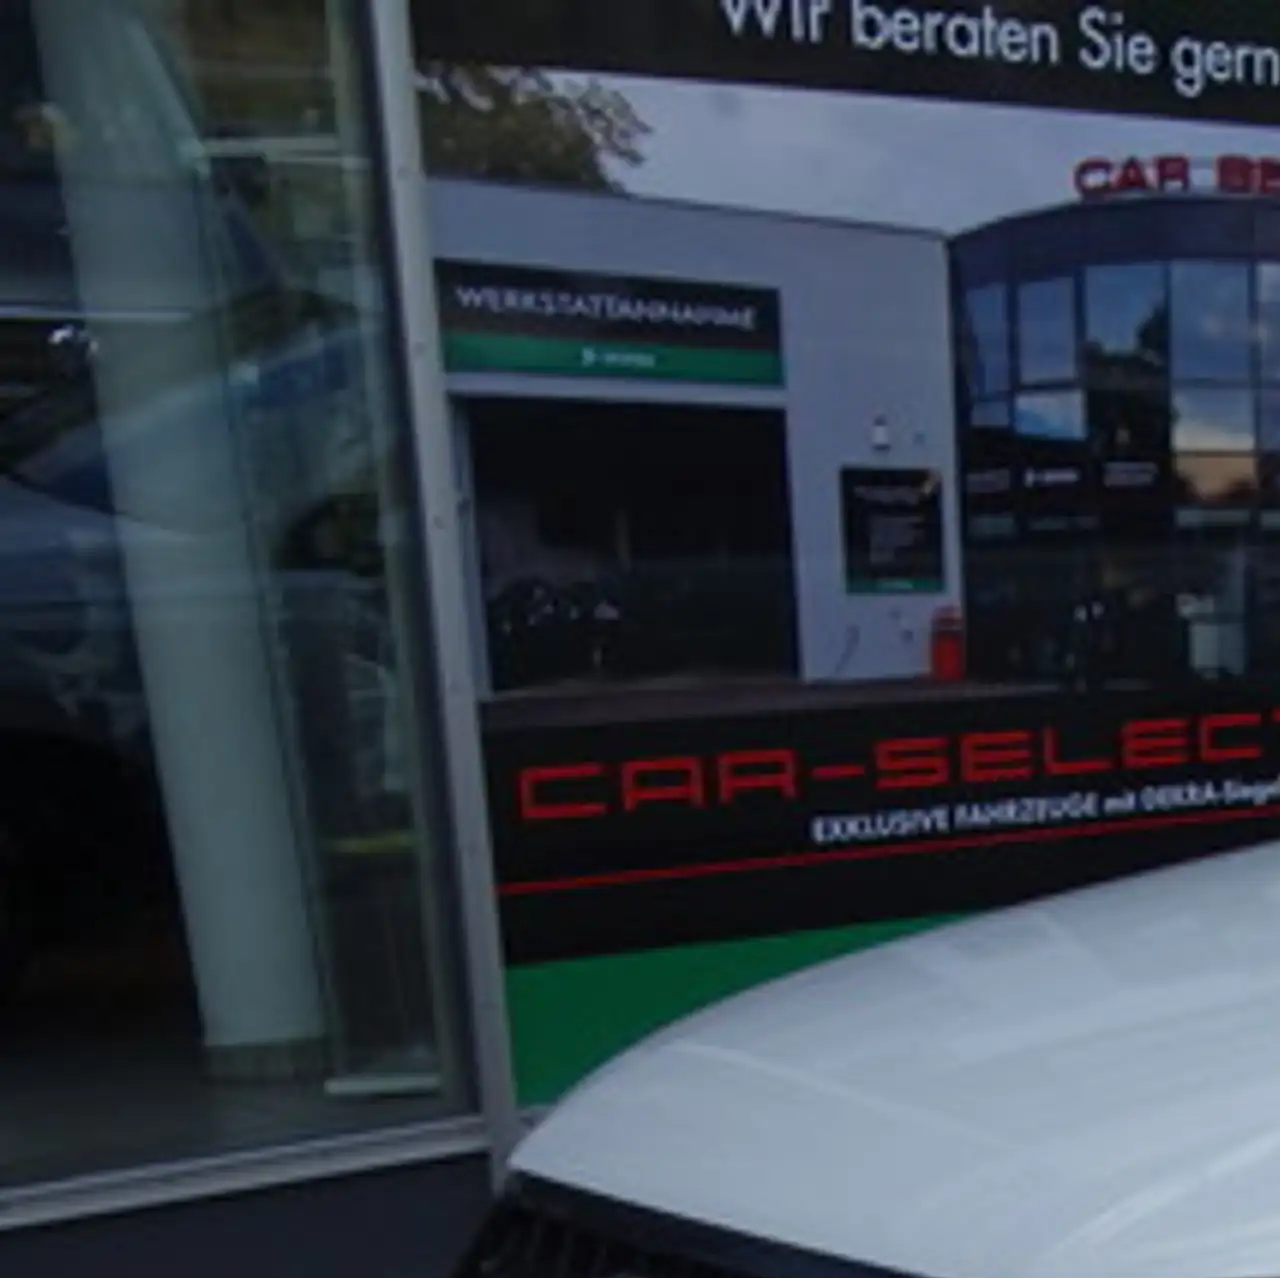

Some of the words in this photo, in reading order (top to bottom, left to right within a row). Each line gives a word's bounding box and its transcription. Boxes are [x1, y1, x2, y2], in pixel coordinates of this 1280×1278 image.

[720, 0, 825, 41] Wir
[851, 0, 1060, 65] beraten
[1078, 6, 1157, 75] Sie
[1074, 154, 1190, 199] CAR
[811, 806, 949, 843] EXKLUSIVE
[954, 791, 1098, 828] FAHRZEUGE
[1103, 785, 1136, 812] mit
